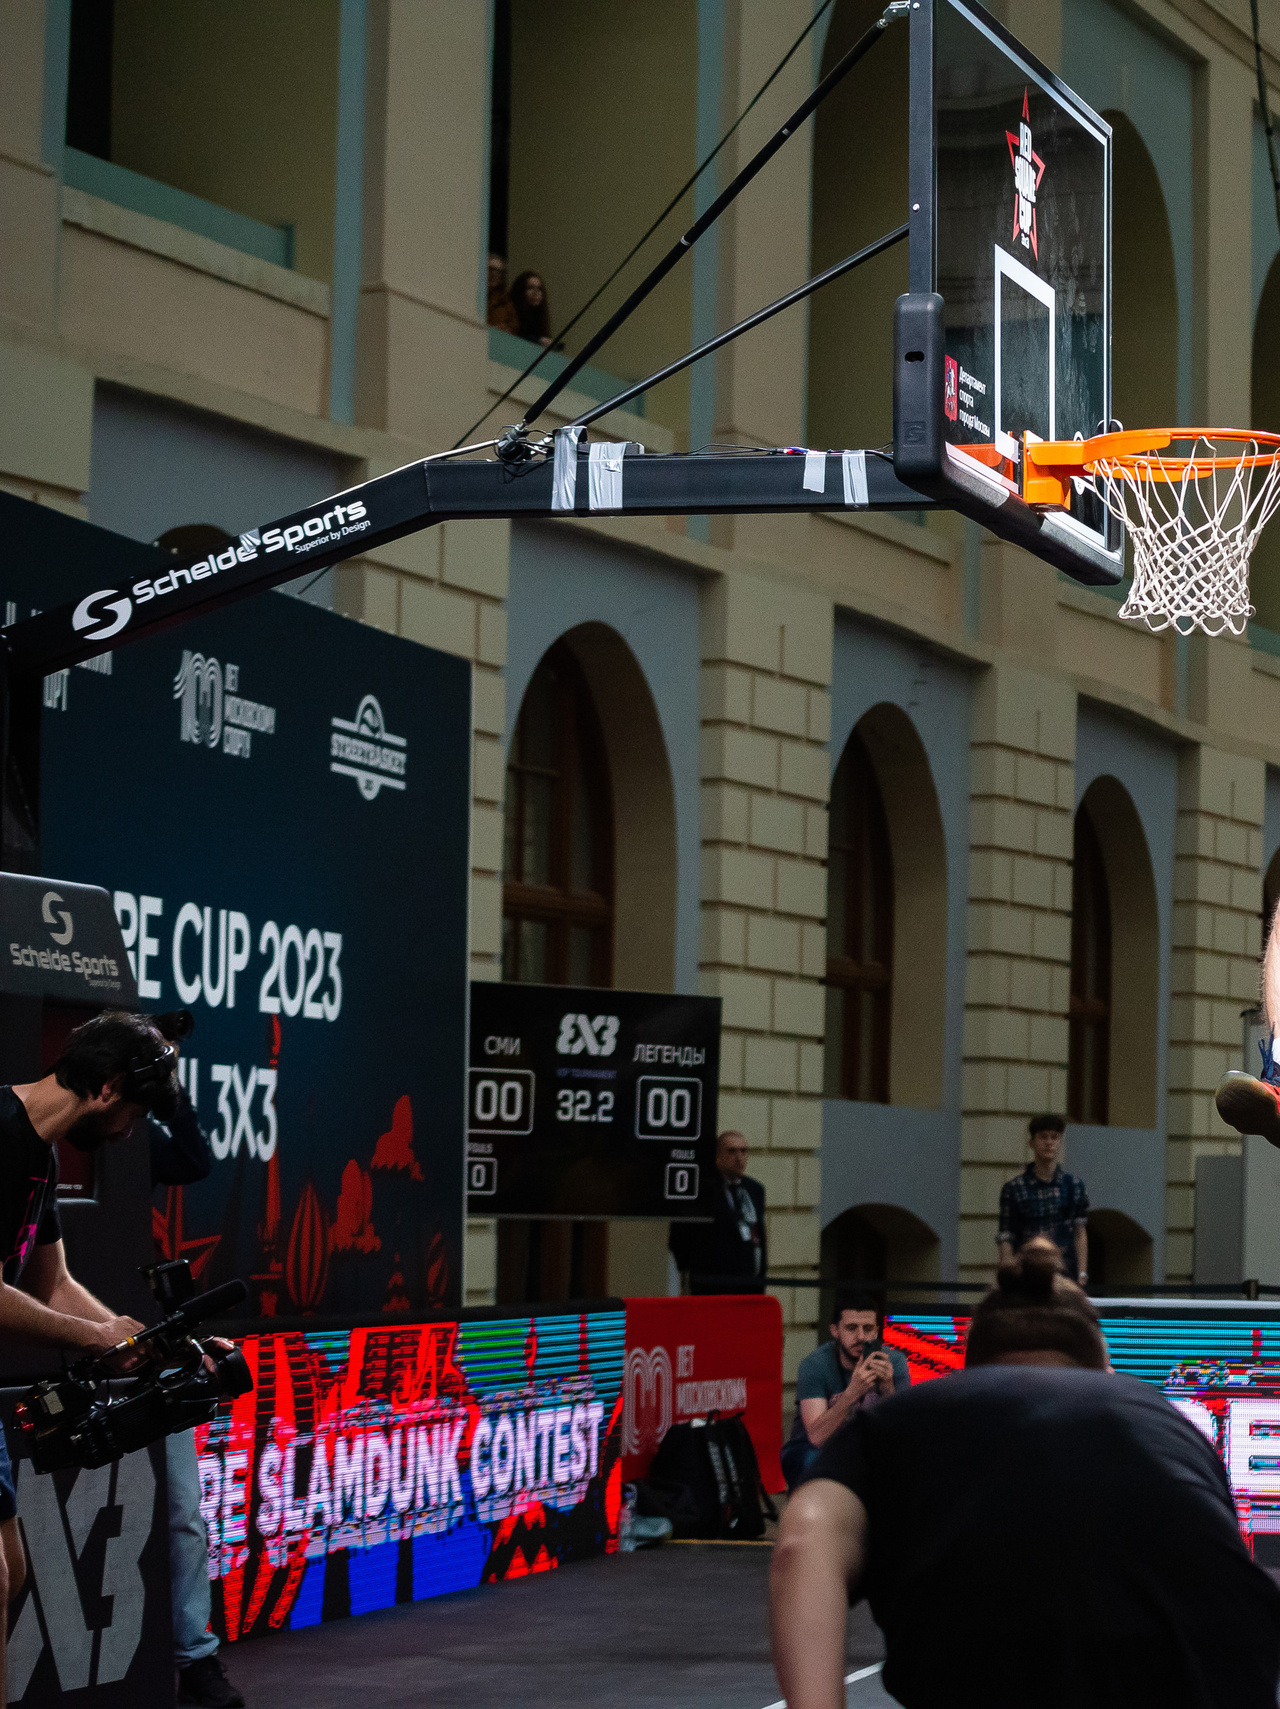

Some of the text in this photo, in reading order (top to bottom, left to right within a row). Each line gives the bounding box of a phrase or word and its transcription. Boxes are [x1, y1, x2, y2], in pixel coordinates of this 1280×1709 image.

[132, 500, 368, 605] Schelde Sports
[295, 518, 372, 554] Superior by Design
[9, 942, 119, 981] Schelde Sports
[172, 901, 251, 1009] CUP
[258, 920, 343, 1022] 2023
[484, 1035, 521, 1056] СМИ
[632, 1043, 706, 1067] ЛЕГЕНДЫ
[210, 1063, 278, 1162] 3X3
[474, 1079, 524, 1122] 00
[556, 1088, 615, 1122] 32.2
[646, 1087, 691, 1128] 00
[675, 1169, 689, 1193] 0
[256, 1420, 468, 1536] SLAMDUNK
[469, 1400, 604, 1500] CONTEST
